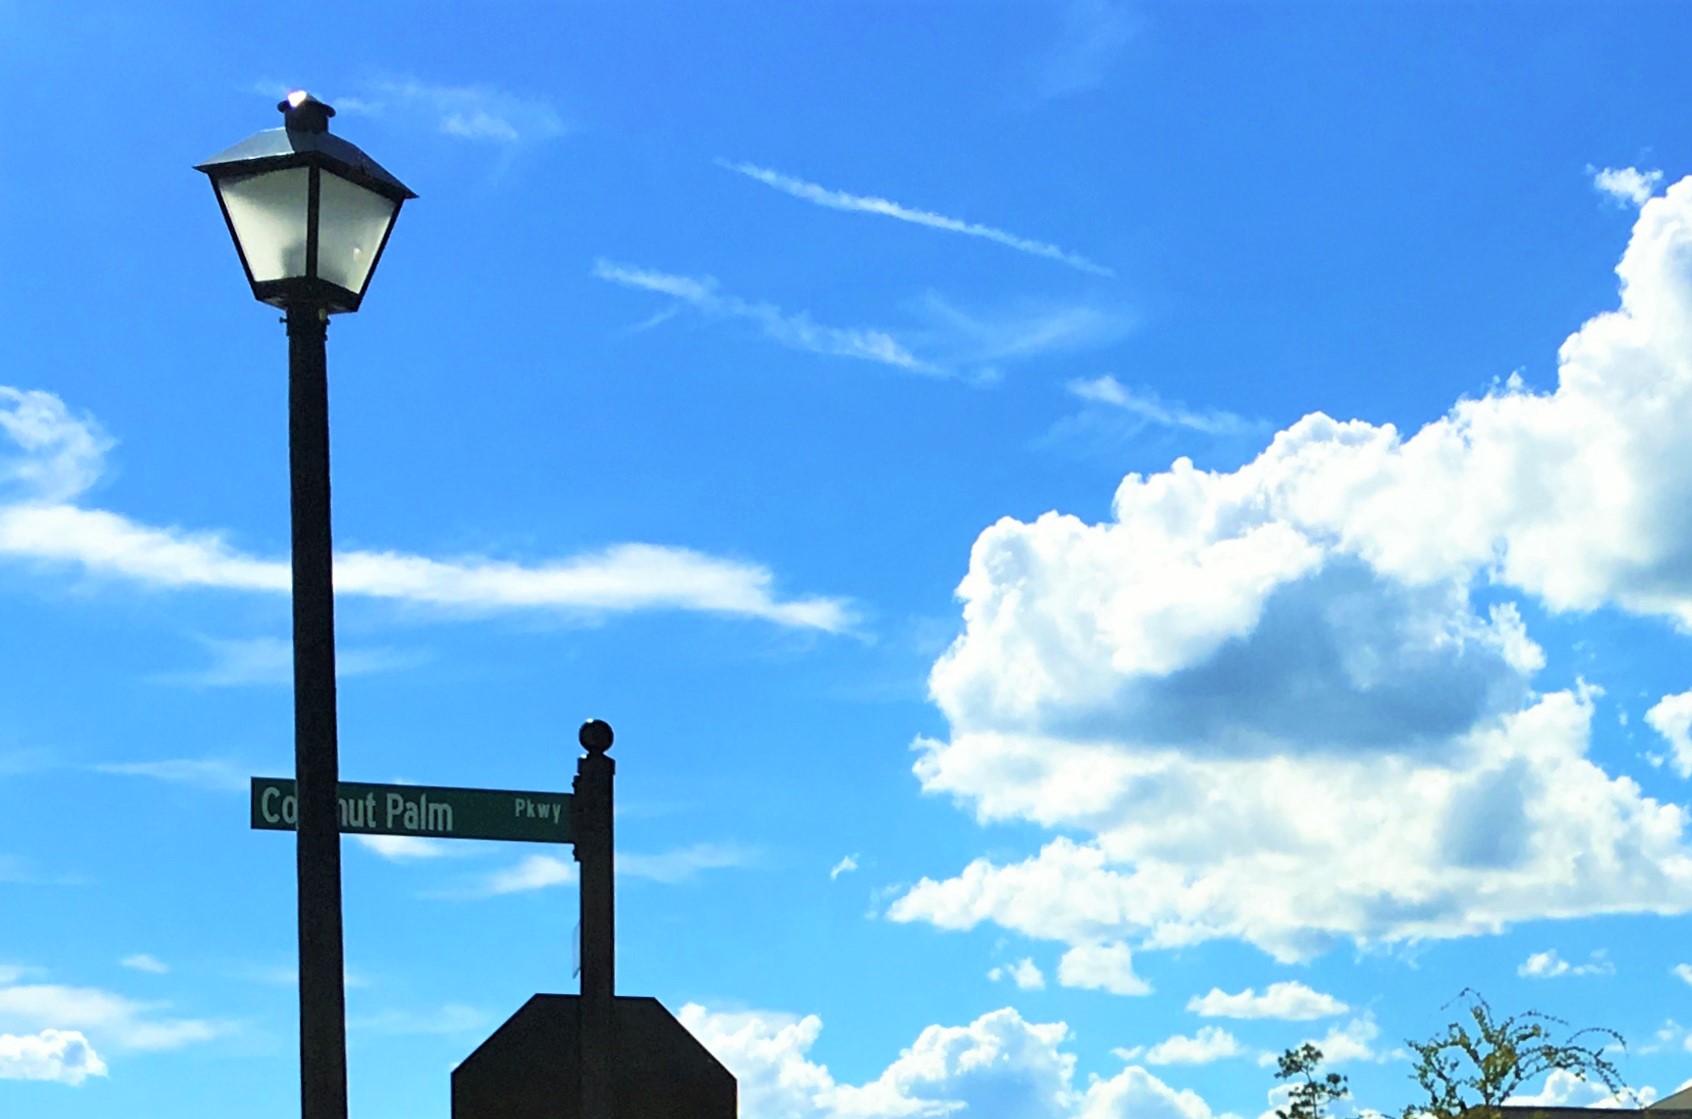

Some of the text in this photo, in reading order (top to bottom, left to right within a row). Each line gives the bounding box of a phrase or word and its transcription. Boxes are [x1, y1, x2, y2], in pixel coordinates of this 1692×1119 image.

[261, 786, 561, 831] Conut Palm Pkwy
